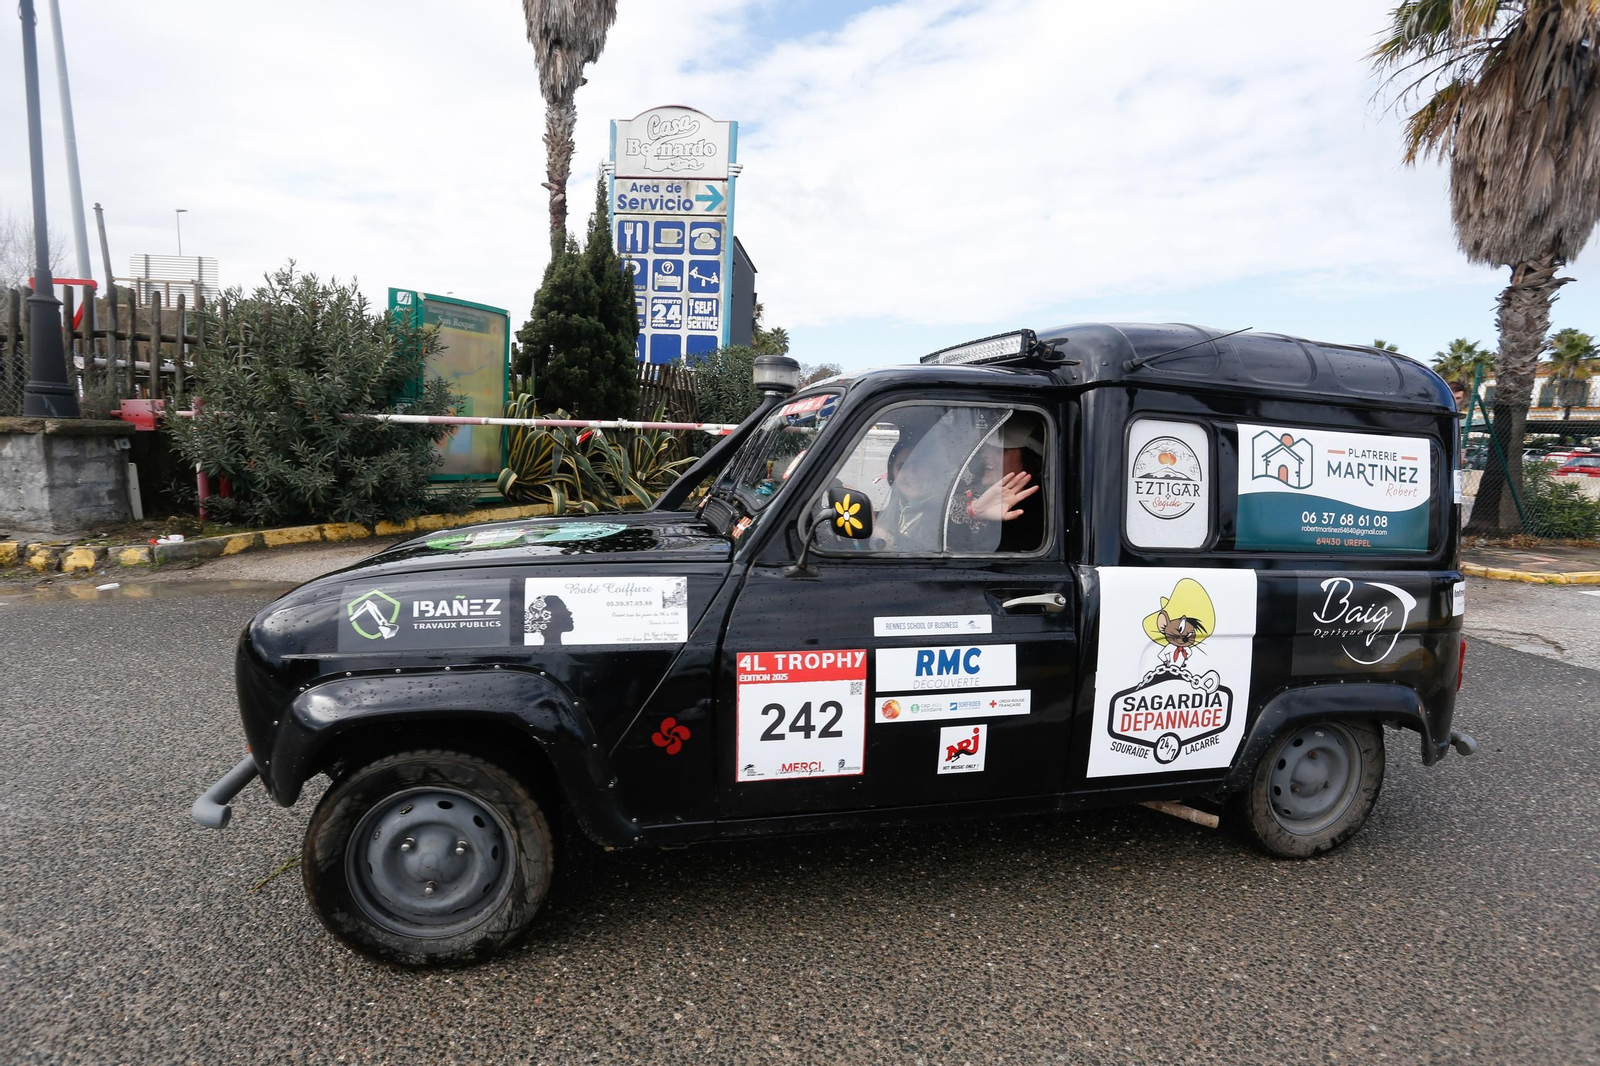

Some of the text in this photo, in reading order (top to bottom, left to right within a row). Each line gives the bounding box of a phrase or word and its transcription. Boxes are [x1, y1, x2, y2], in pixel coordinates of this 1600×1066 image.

[647, 115, 700, 140] Casa
[630, 182, 682, 193] Area de
[617, 194, 694, 211] Servicio
[652, 303, 682, 324] 24
[694, 300, 712, 314] SELF
[687, 316, 718, 330] SERVICE
[1348, 448, 1398, 462] PLATRERIE
[1327, 460, 1418, 486] MARTINEZ
[1135, 481, 1201, 498] EZTIGAR
[1385, 483, 1418, 498] Robert
[1301, 511, 1388, 528] 06 37 68 61 08
[1316, 537, 1371, 547] 64430 UREPEL
[565, 582, 654, 597] Babé Coiffure
[412, 595, 502, 618] IBAÑEZ
[1312, 577, 1393, 646] Baig
[413, 620, 502, 630] TRAVAUX PUBLICS
[885, 622, 906, 630] RENNES
[907, 622, 926, 630] SCHOOL
[934, 621, 959, 629] BUSINESS
[1313, 628, 1364, 638] Optique
[739, 651, 866, 672] 4L TROPHY
[915, 647, 982, 677] RMC
[913, 675, 981, 690] DÉCOUVERTE
[1122, 692, 1223, 712] SAGARDIA
[760, 700, 843, 742] 242
[1120, 709, 1223, 733] DEPANNAGE
[1110, 735, 1220, 760] SOURAÏDE 24/7 LACARRE
